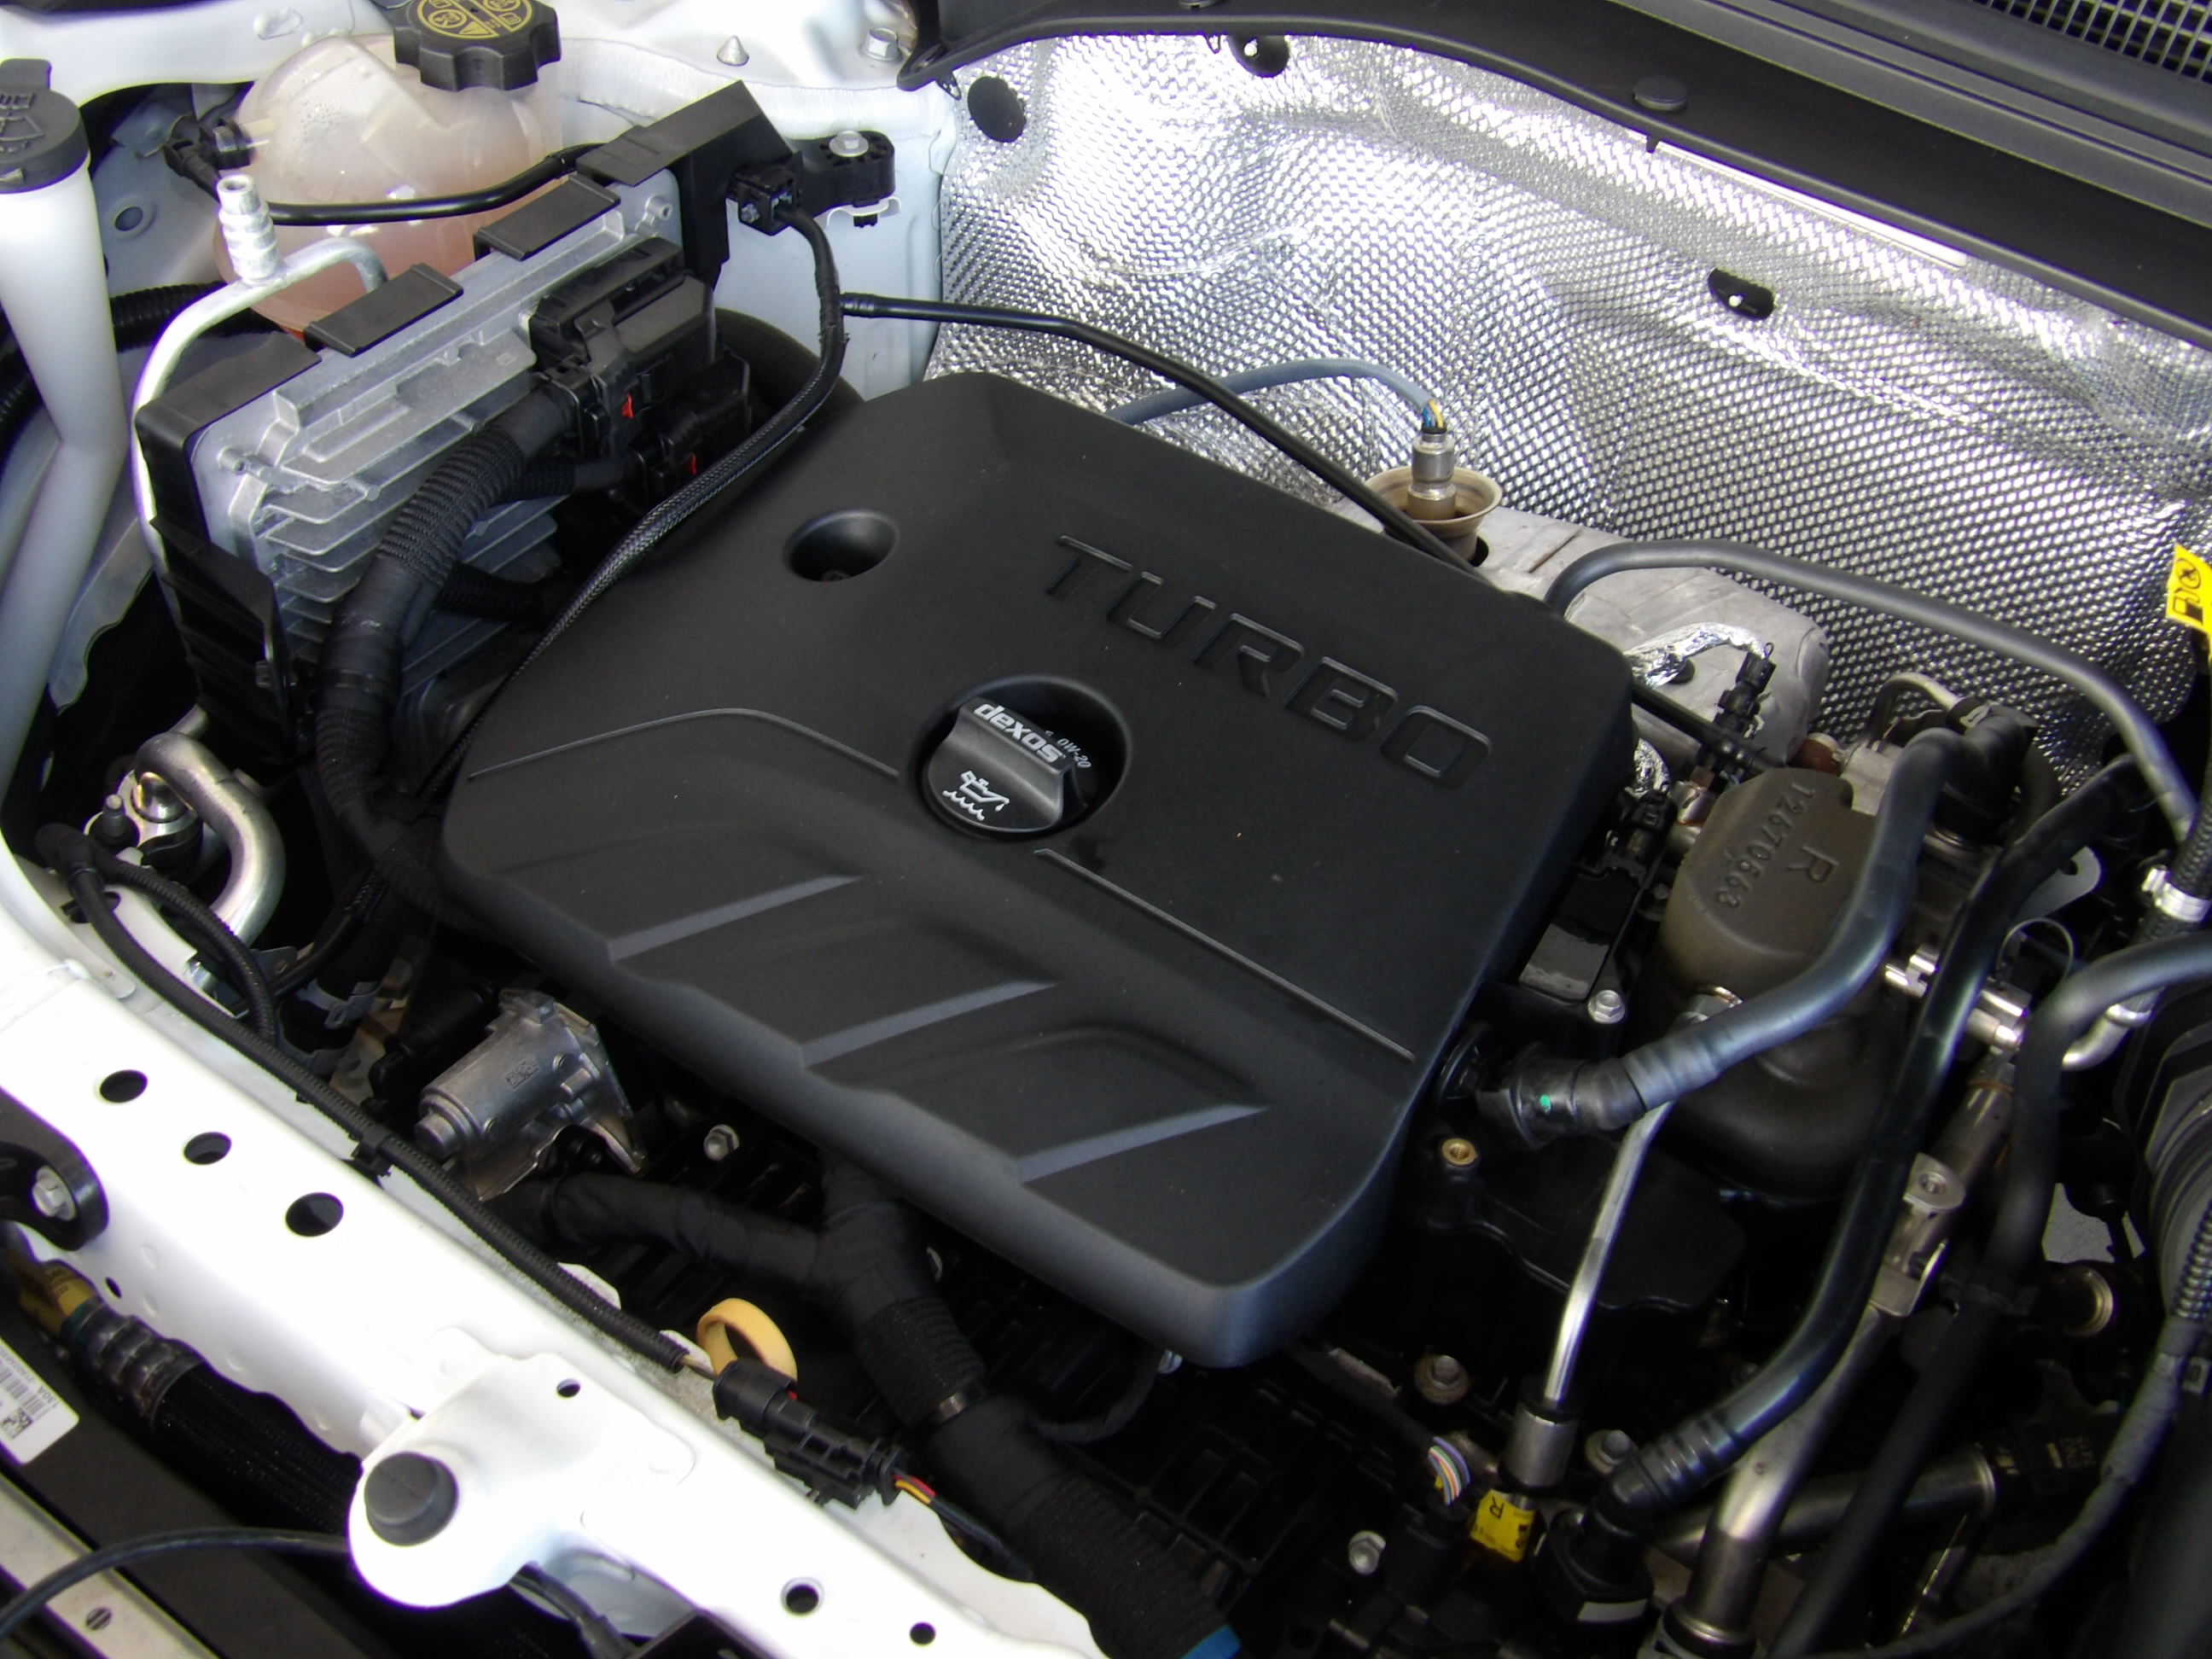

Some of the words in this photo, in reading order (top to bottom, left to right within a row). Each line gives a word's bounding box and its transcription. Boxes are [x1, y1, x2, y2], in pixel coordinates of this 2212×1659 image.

[1047, 535, 1492, 789] TURBO
[974, 703, 1063, 763] dexos
[1787, 846, 1840, 882] R
[1489, 1495, 1505, 1520] R
